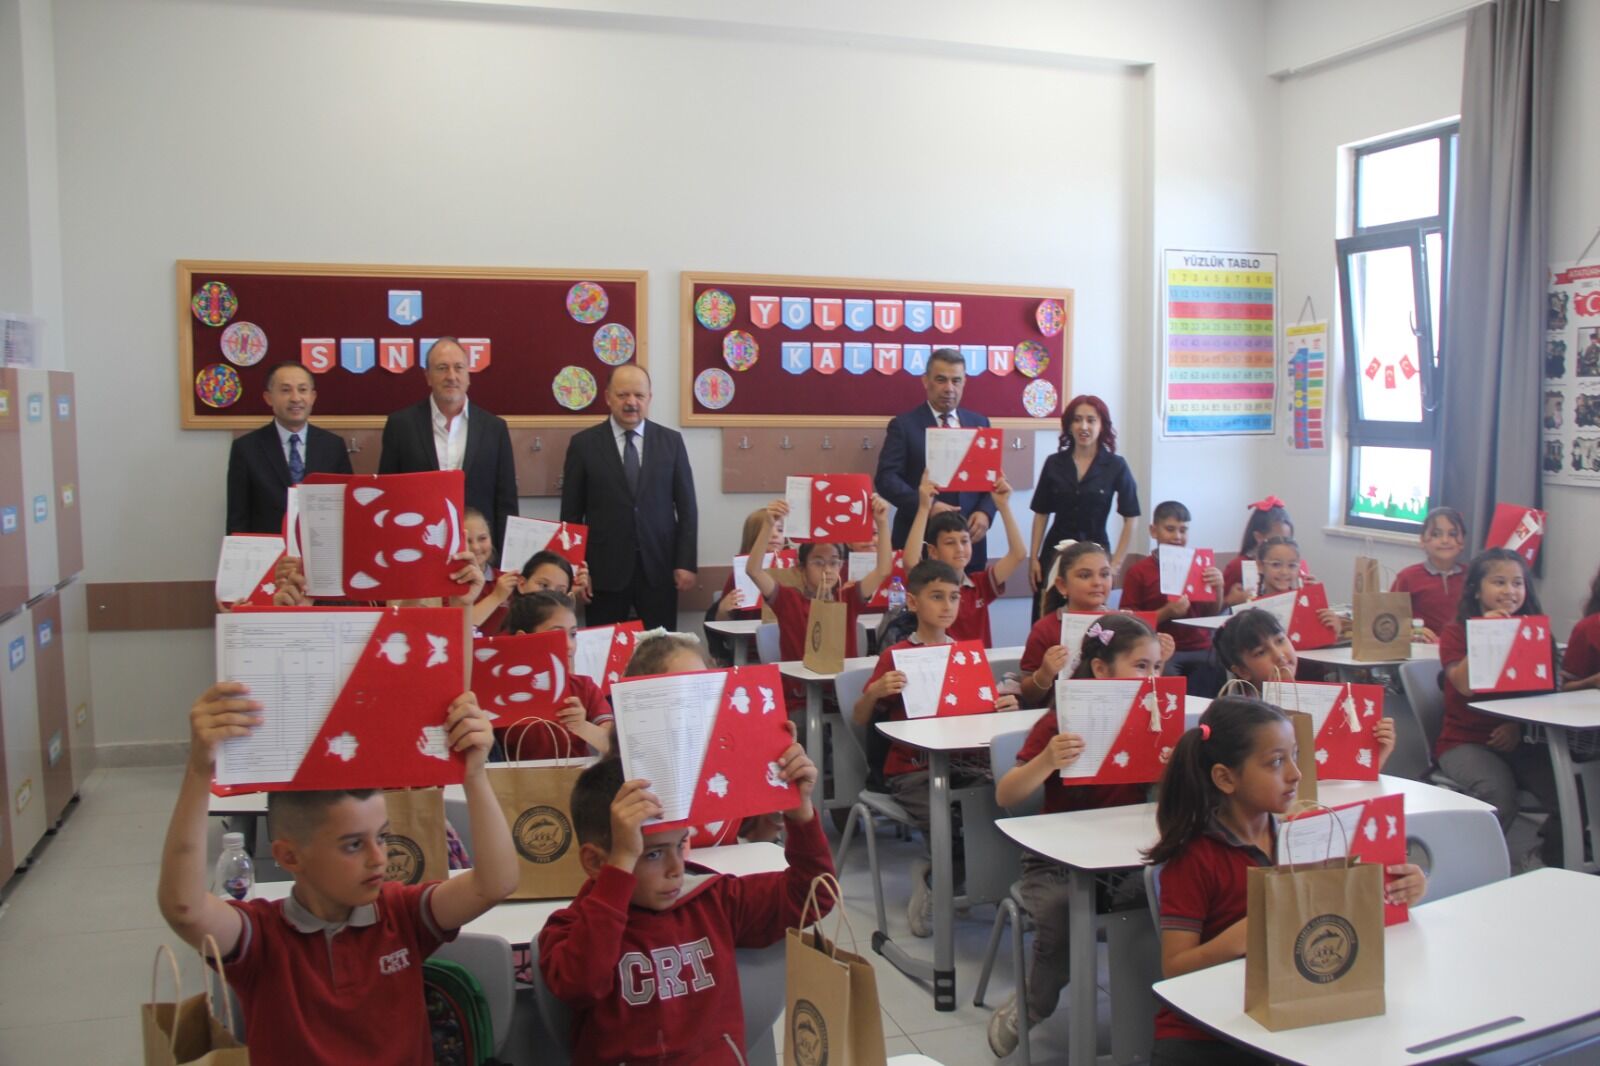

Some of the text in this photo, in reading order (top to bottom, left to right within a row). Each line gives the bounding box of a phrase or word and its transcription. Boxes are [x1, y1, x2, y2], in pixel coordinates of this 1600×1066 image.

[1184, 255, 1261, 269] YÜZLÜK TABLO
[395, 298, 417, 320] 4.
[757, 303, 955, 329] YOLCUSU
[310, 344, 486, 369] SINF
[789, 347, 1009, 371] KALMAIN
[379, 948, 410, 975] CRT
[618, 937, 716, 1005] CRT
